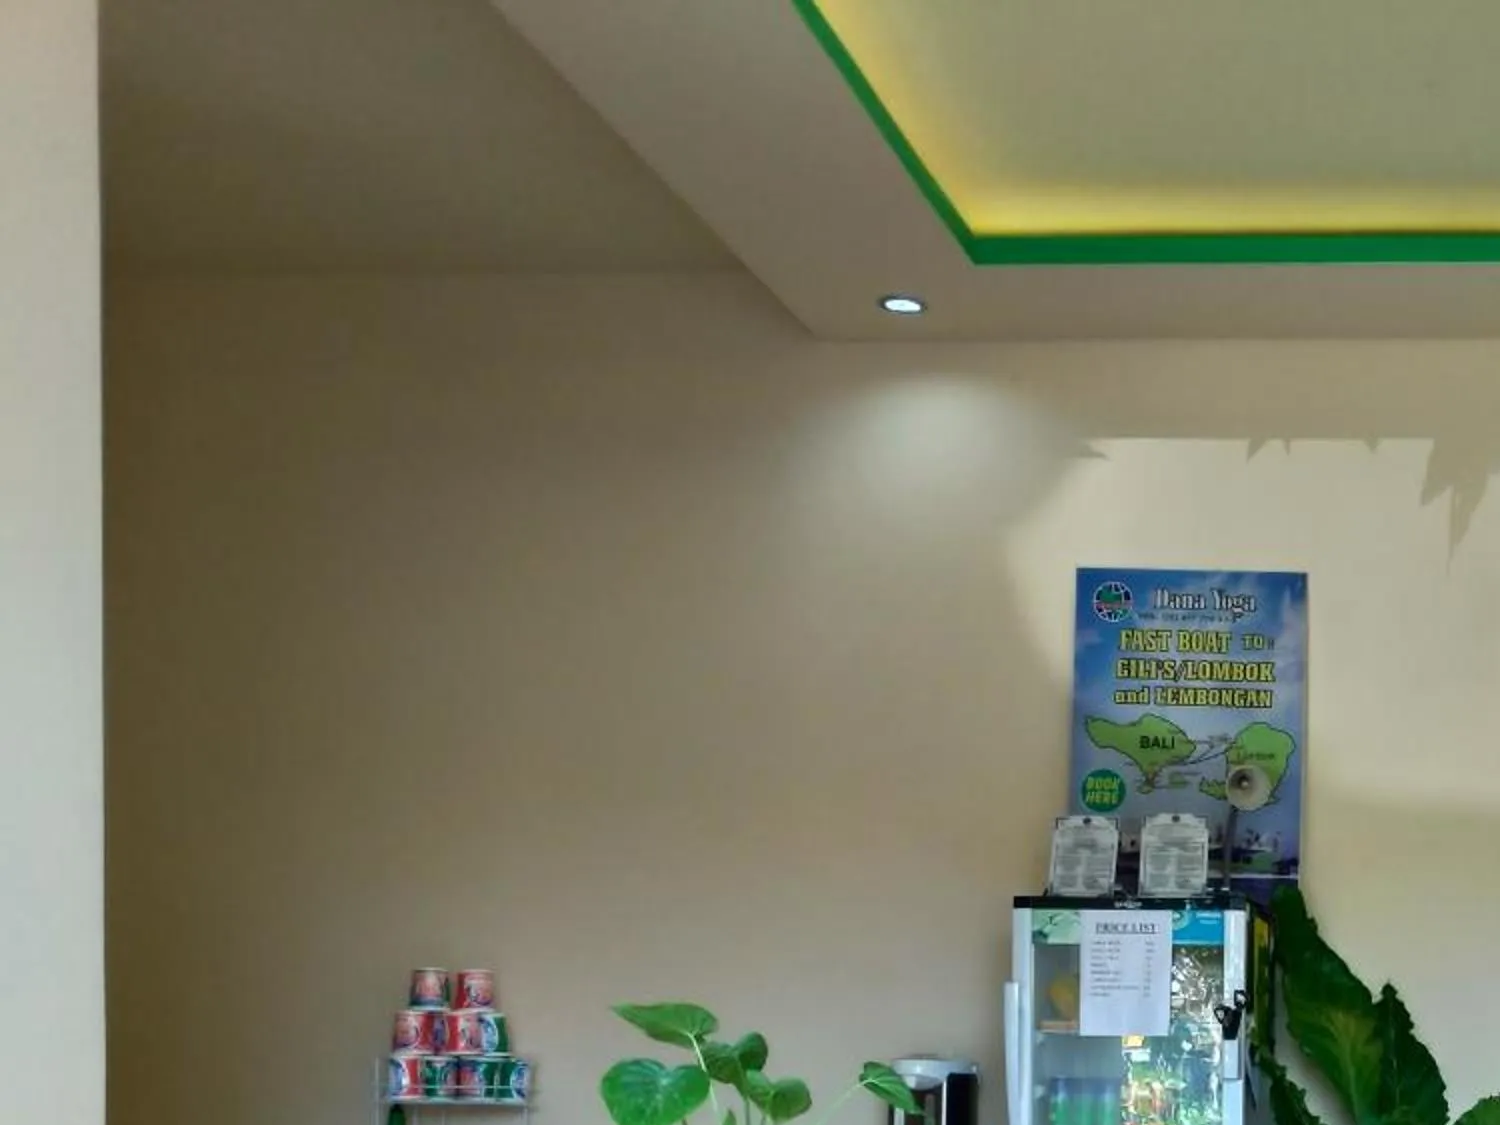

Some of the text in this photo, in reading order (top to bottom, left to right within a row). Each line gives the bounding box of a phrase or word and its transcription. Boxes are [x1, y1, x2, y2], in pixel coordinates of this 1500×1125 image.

[1210, 587, 1257, 615] Yoga
[1119, 628, 1172, 652] FAST
[1177, 629, 1232, 654] BOAT
[1114, 686, 1273, 708] and LEMBONGAN
[1139, 735, 1175, 750] BALI
[1085, 791, 1118, 804] HERE
